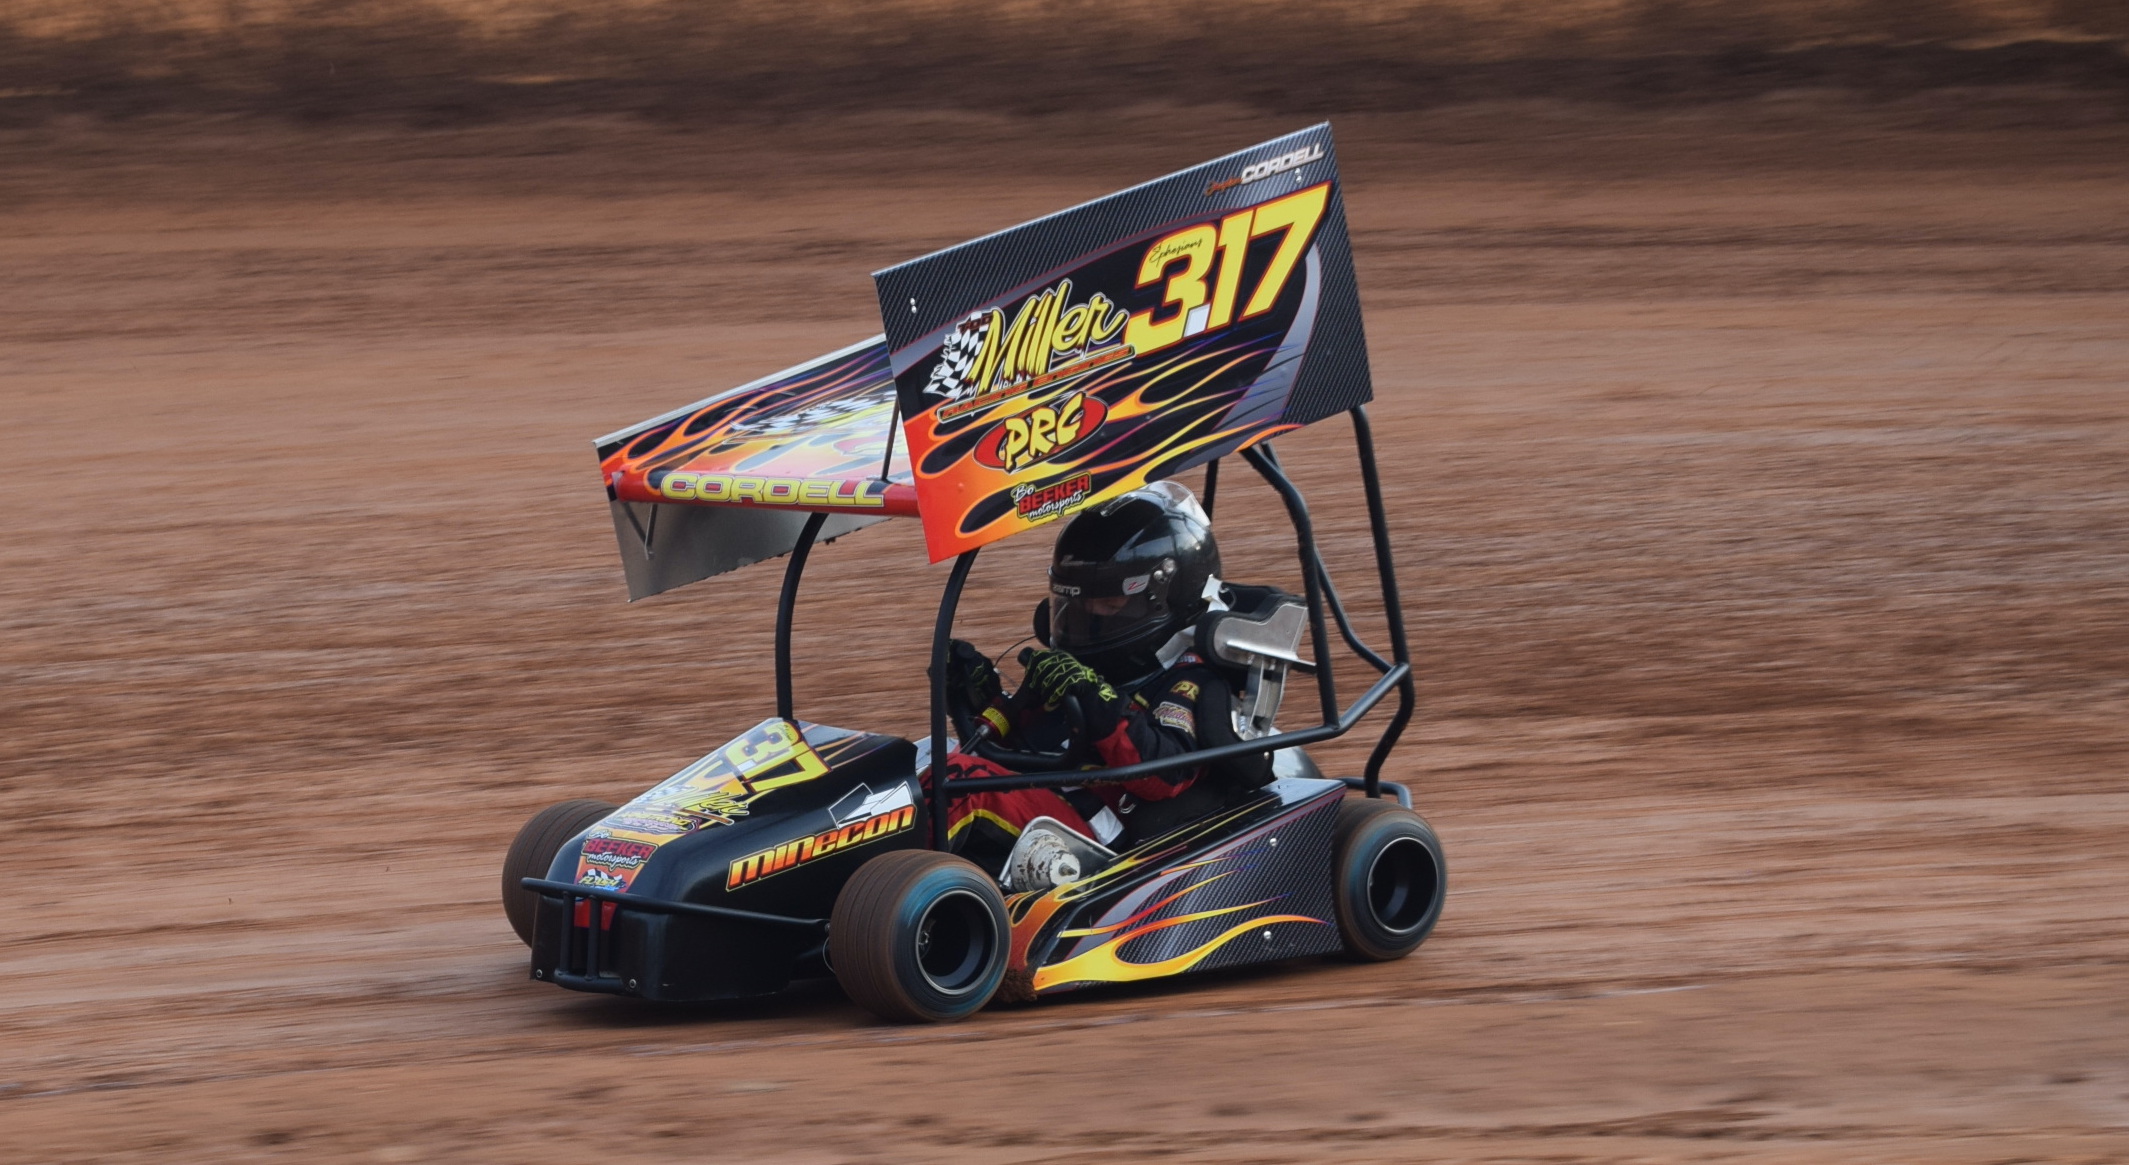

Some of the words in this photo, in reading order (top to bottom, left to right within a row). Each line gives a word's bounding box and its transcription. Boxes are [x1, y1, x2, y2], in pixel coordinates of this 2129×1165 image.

[1241, 143, 1324, 185] CORDELL
[1149, 238, 1203, 267] Ephesians
[965, 281, 1128, 397] Miller
[1003, 390, 1084, 471] PRC
[660, 472, 885, 507] CORDELL
[1014, 484, 1035, 502] Bo
[1018, 474, 1090, 516] BEEKER
[1029, 490, 1083, 519] motorsports
[584, 838, 657, 859] BEEKER
[588, 851, 642, 872] motorsports
[726, 804, 916, 891] minecon
